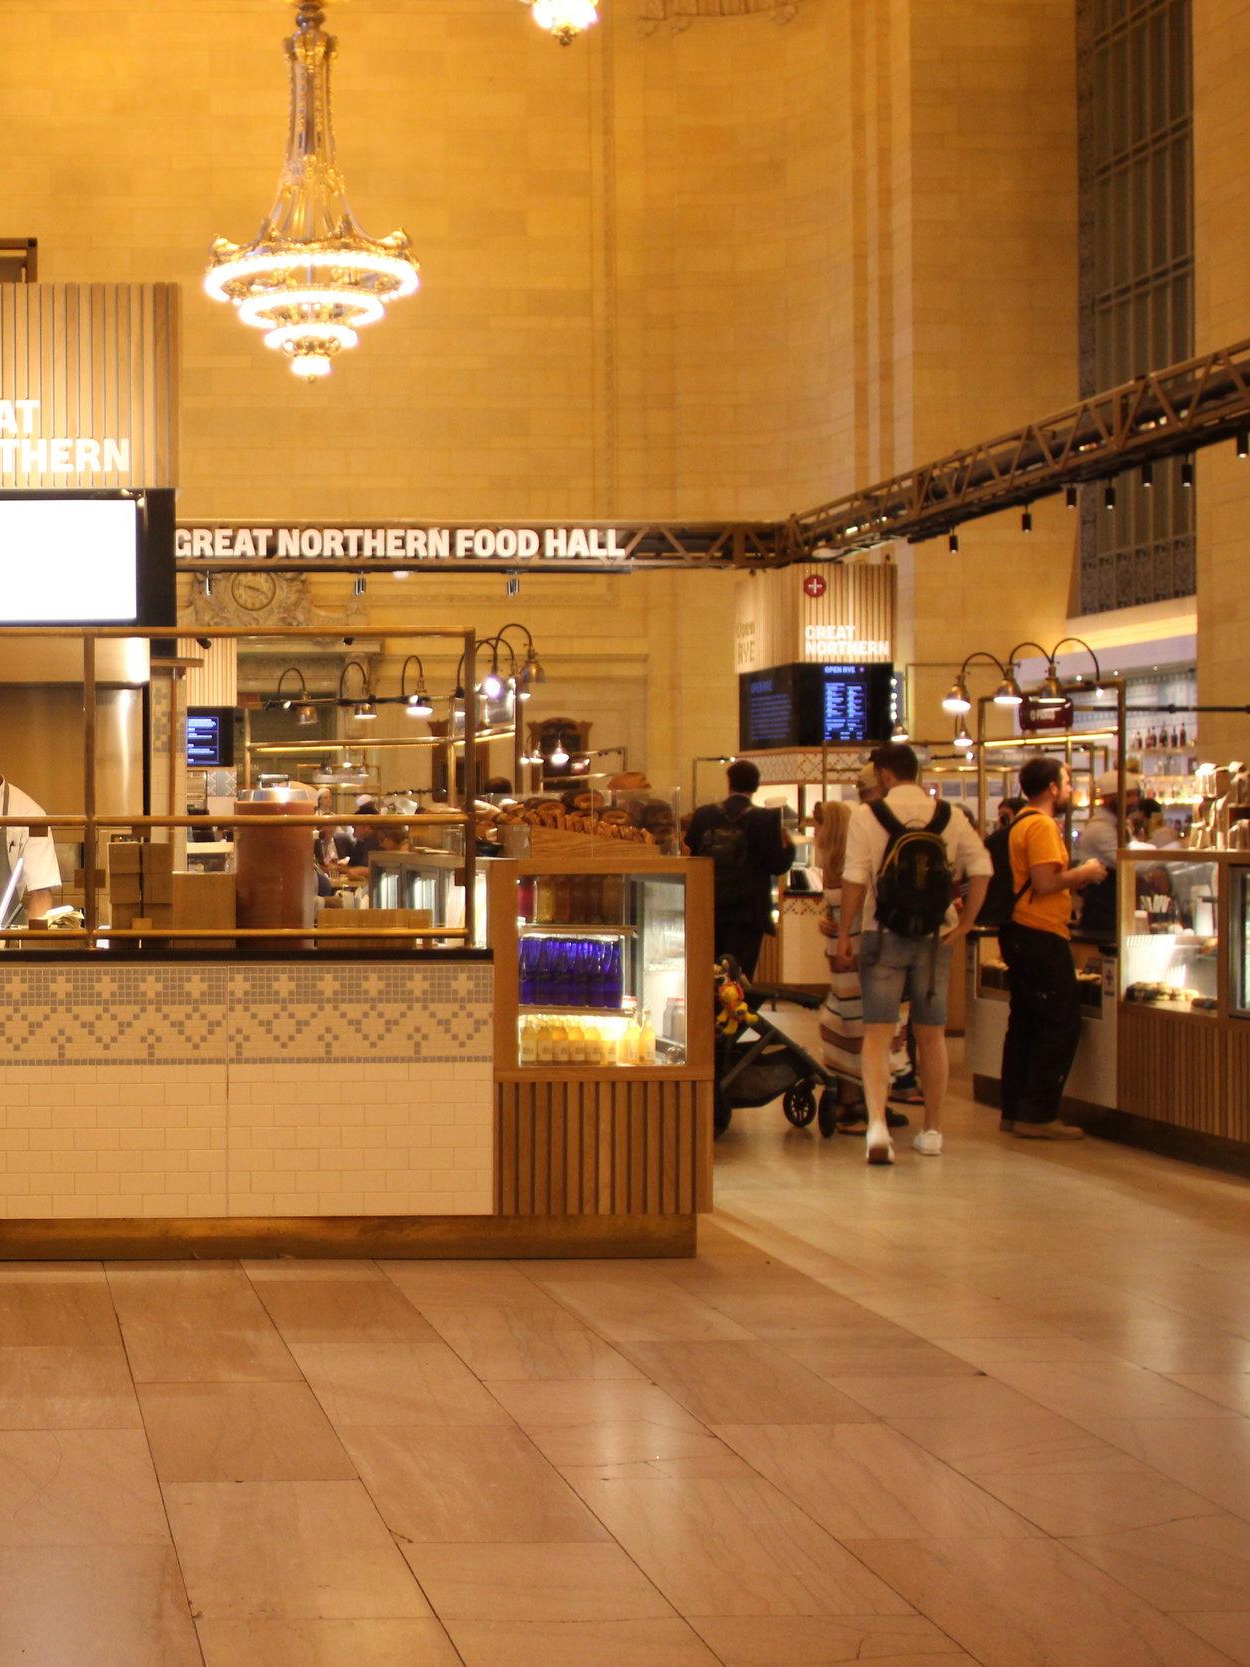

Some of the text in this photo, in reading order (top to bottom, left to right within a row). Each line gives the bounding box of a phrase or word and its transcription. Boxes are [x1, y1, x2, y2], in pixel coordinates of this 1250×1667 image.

[175, 528, 626, 558] GREAT NORTHERN FOOD HALL
[805, 625, 855, 640] GREAT
[805, 641, 889, 655] NORTHERN
[824, 665, 842, 674] OPEN
